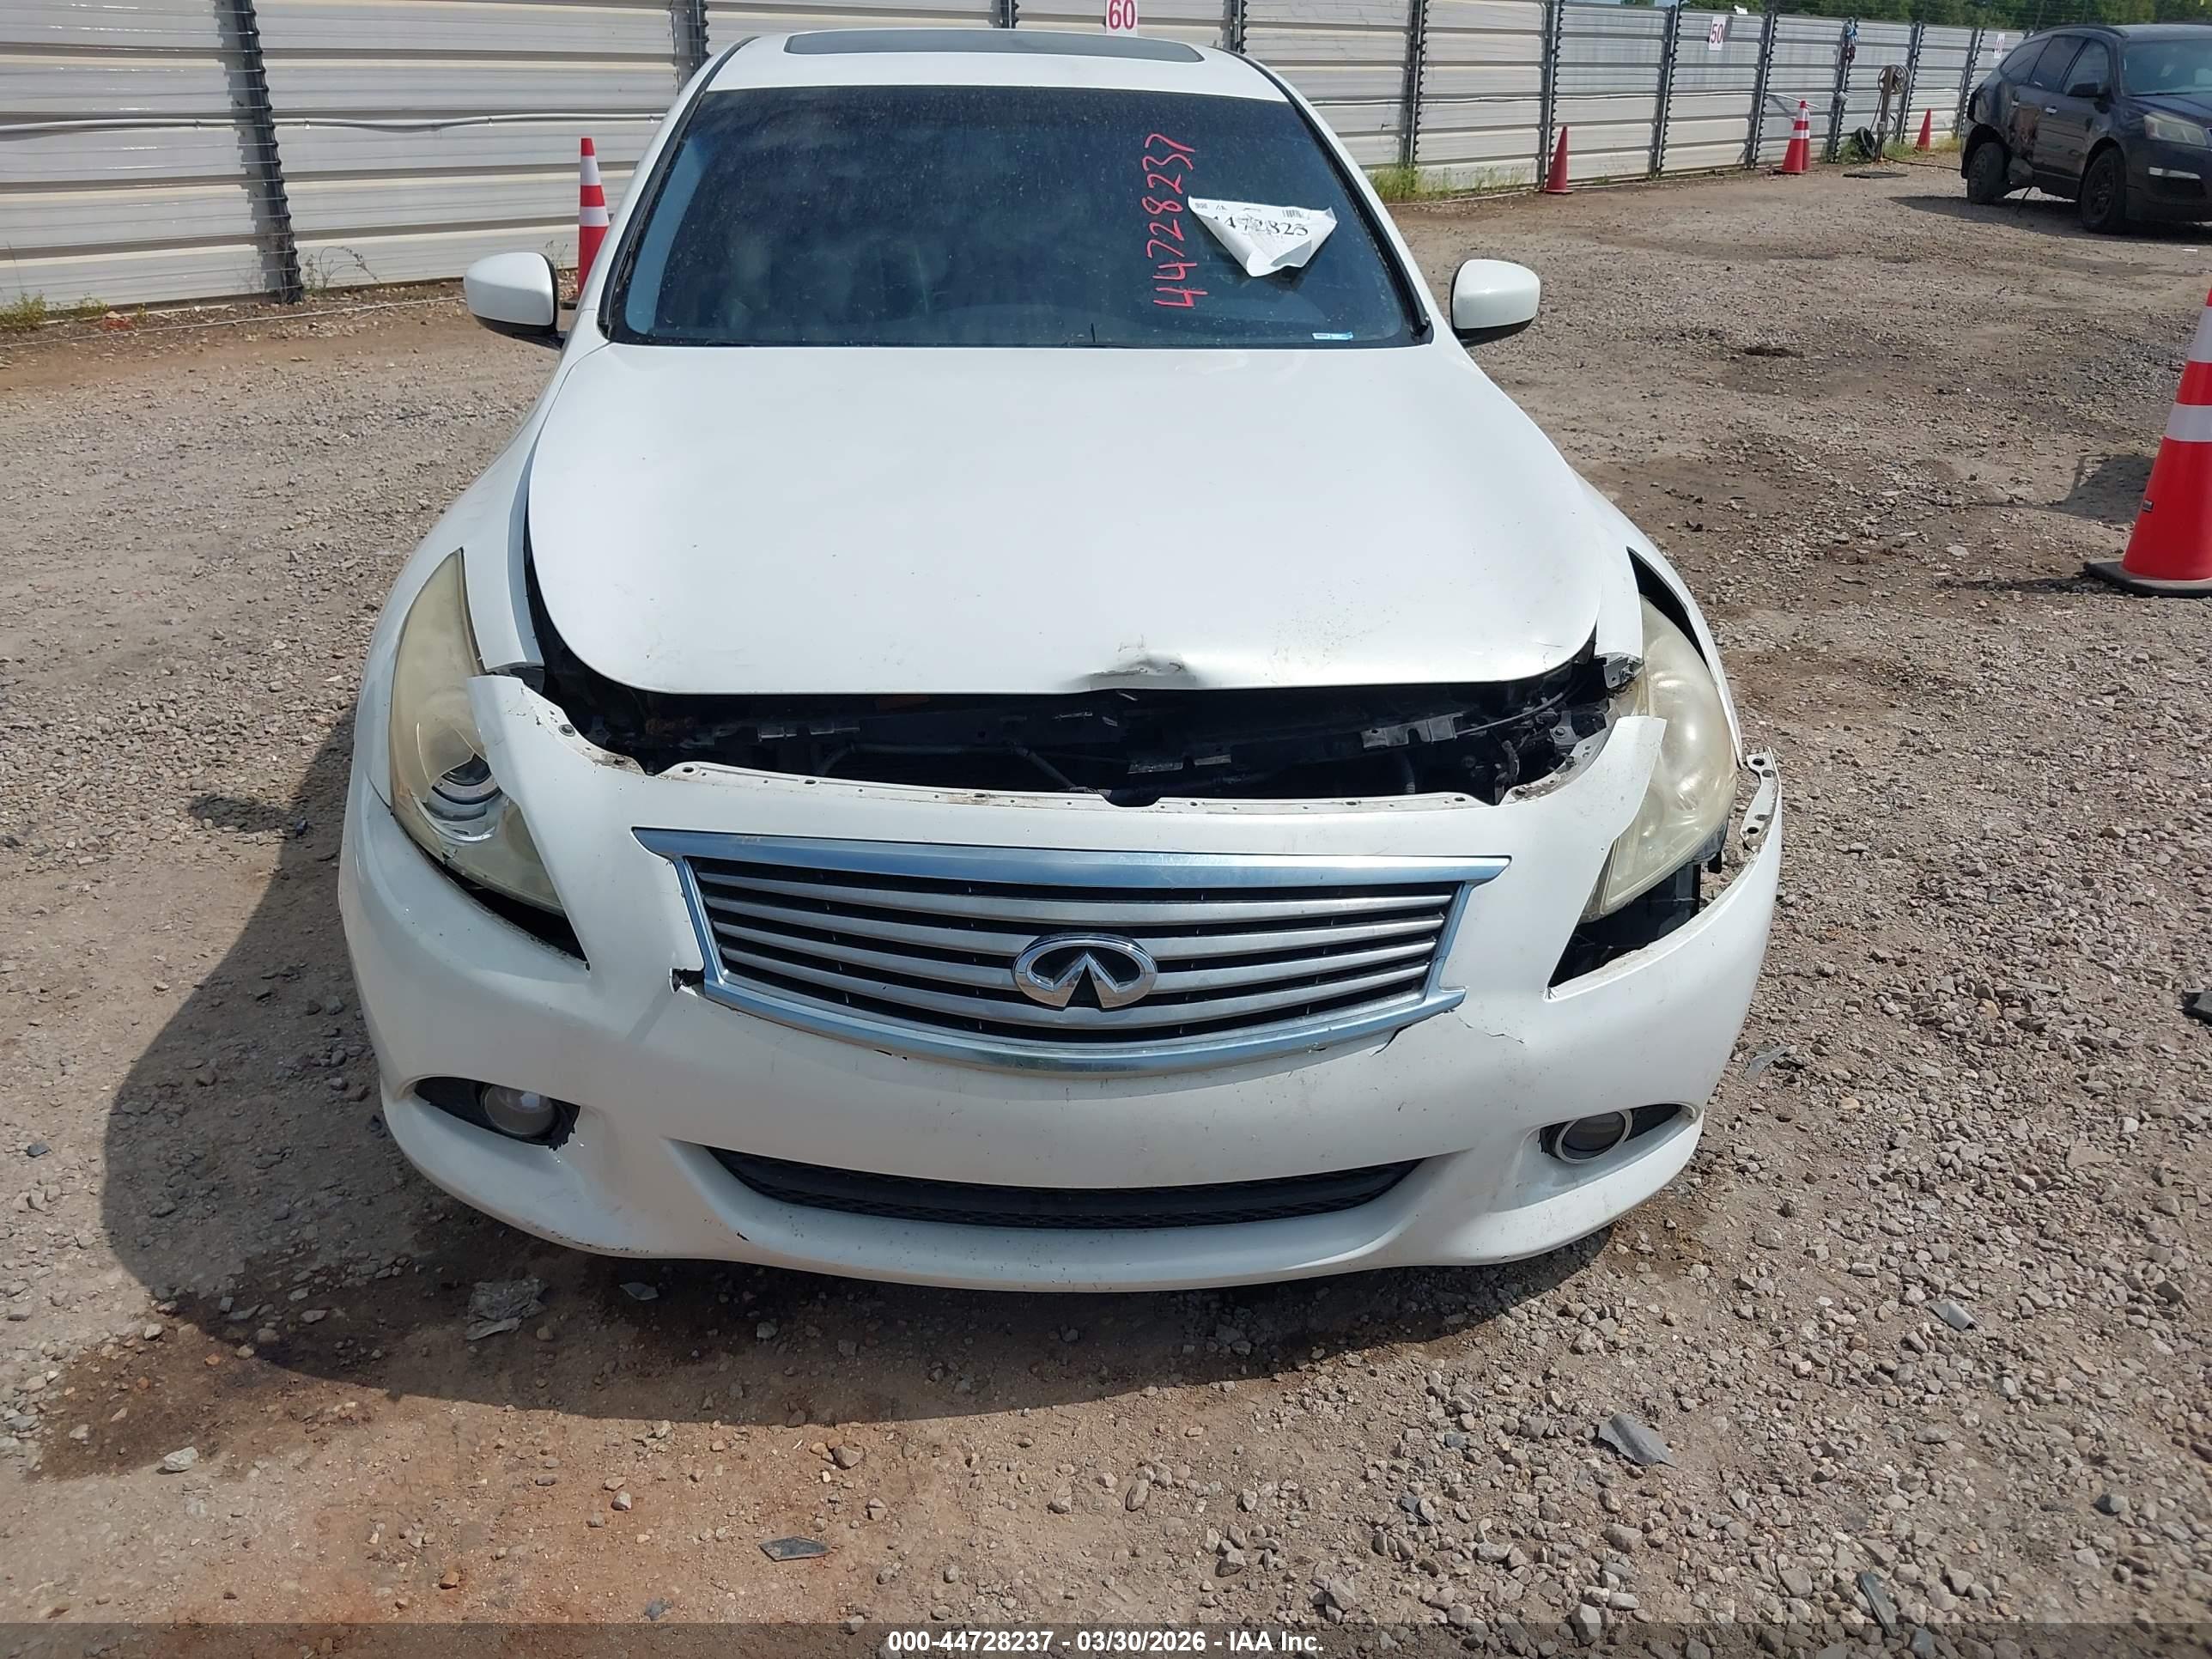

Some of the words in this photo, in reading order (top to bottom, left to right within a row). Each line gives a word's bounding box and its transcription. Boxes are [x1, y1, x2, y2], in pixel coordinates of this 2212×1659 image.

[1109, 0, 1135, 30] 60
[1711, 23, 1723, 44] 50
[1141, 132, 1208, 308] 44728237
